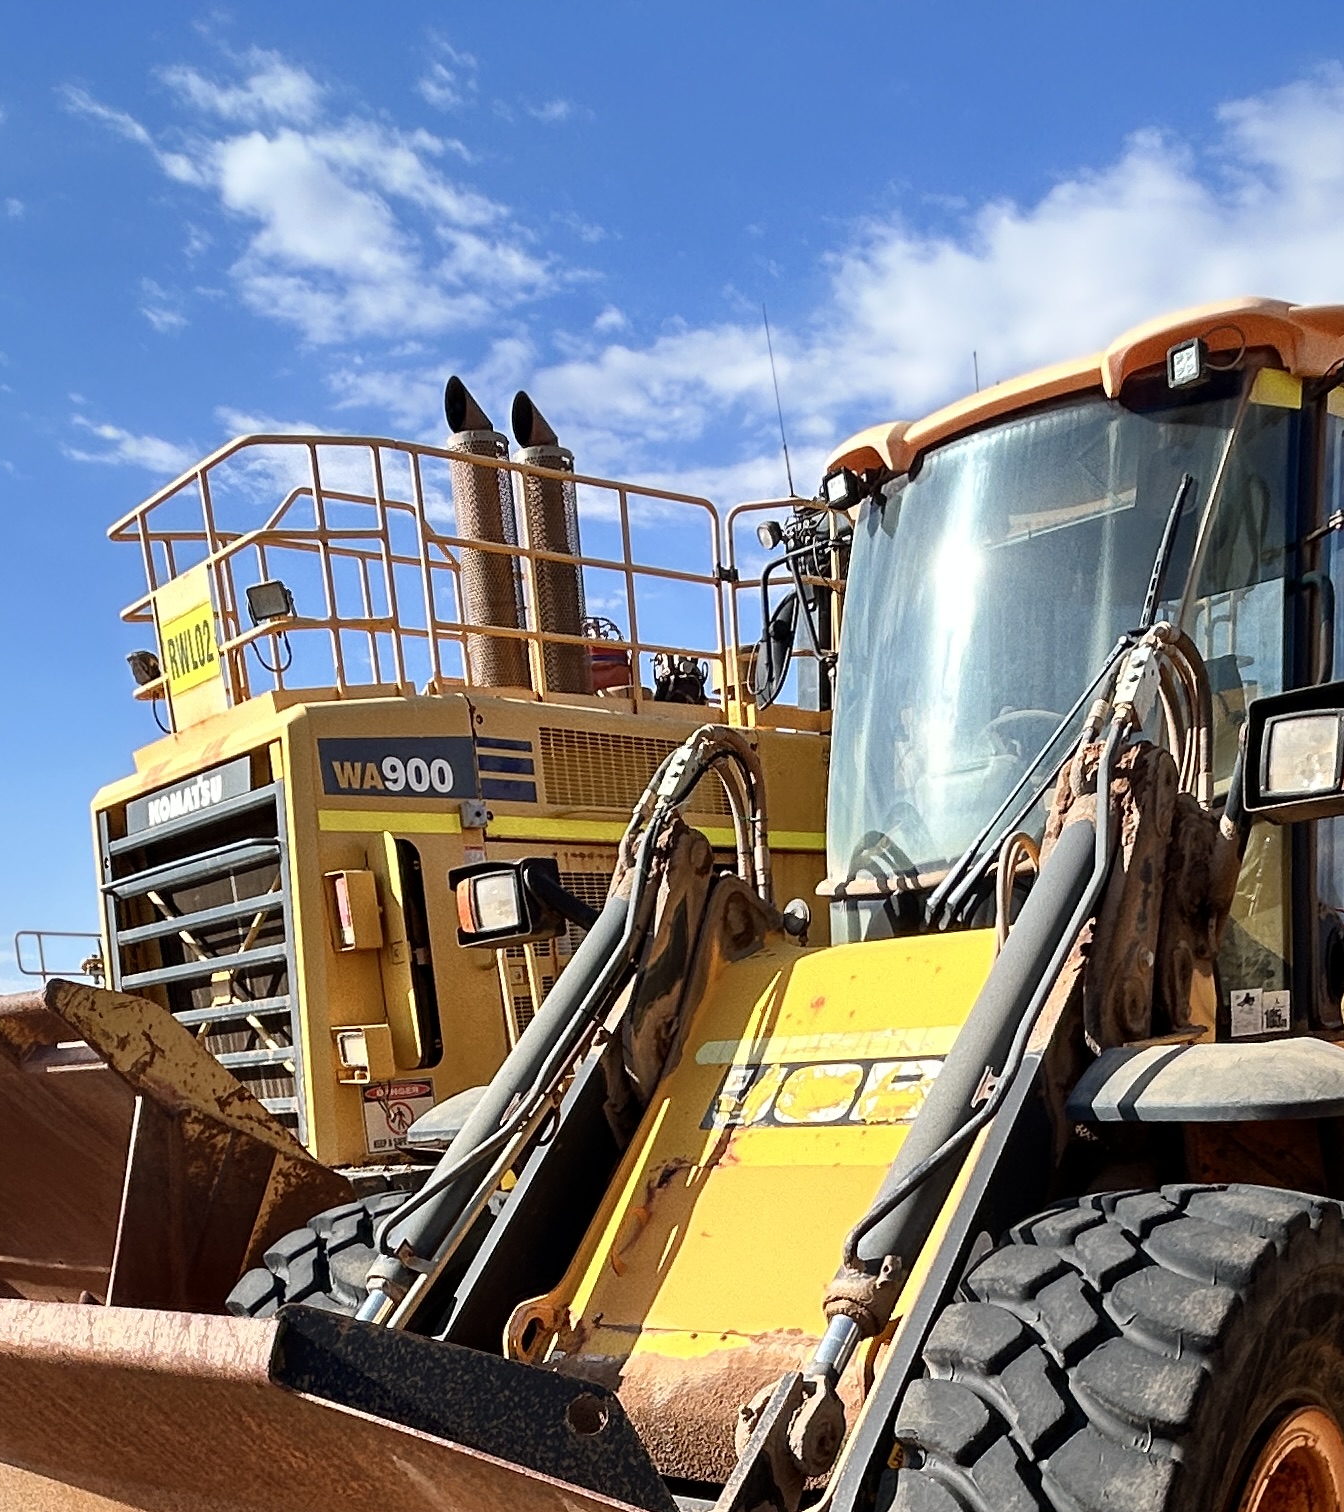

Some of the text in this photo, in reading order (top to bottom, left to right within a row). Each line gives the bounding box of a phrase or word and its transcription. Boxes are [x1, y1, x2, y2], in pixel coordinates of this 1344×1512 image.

[168, 619, 214, 681] RWL02
[147, 774, 223, 827] KOMATSU
[331, 756, 454, 793] WA900
